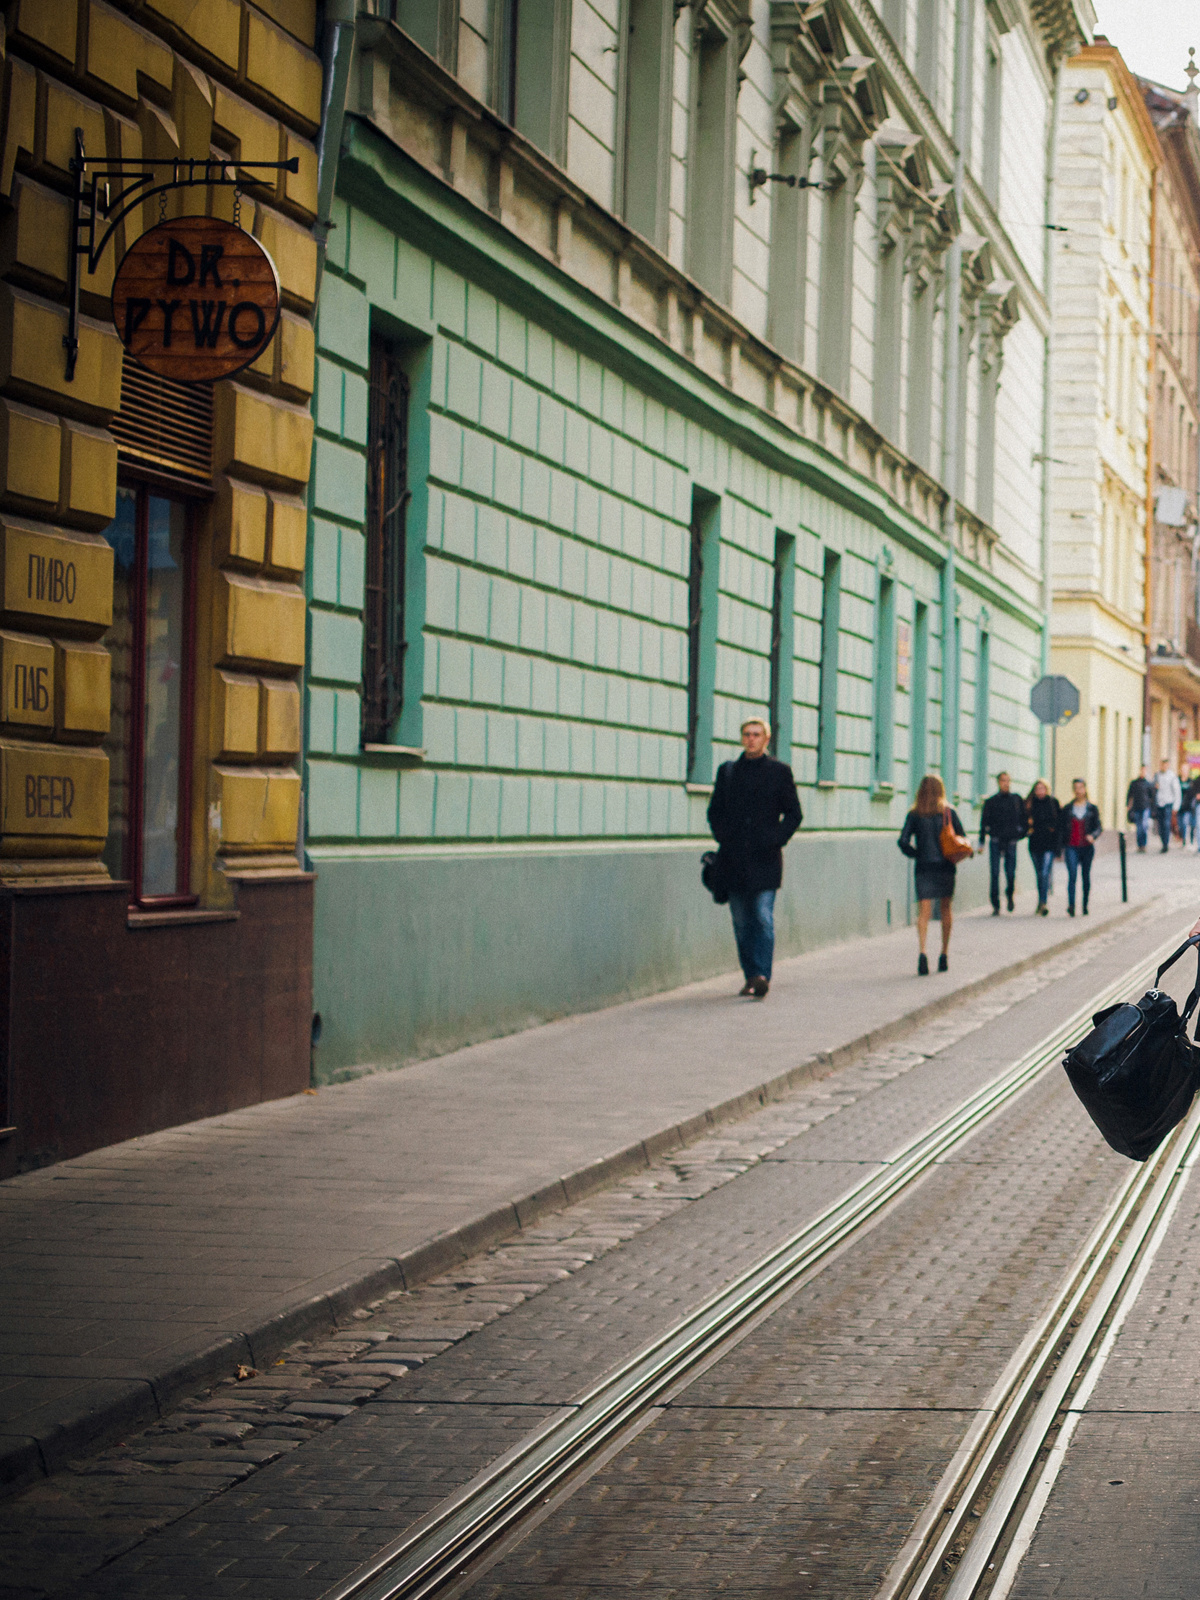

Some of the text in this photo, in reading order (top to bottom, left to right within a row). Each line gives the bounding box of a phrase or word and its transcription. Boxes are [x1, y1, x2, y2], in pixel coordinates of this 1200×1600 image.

[167, 239, 240, 288] DR.
[124, 297, 266, 348] PYWO
[28, 554, 77, 603] ПИВО
[14, 664, 50, 712] ПАБ
[25, 774, 75, 819] BEER
